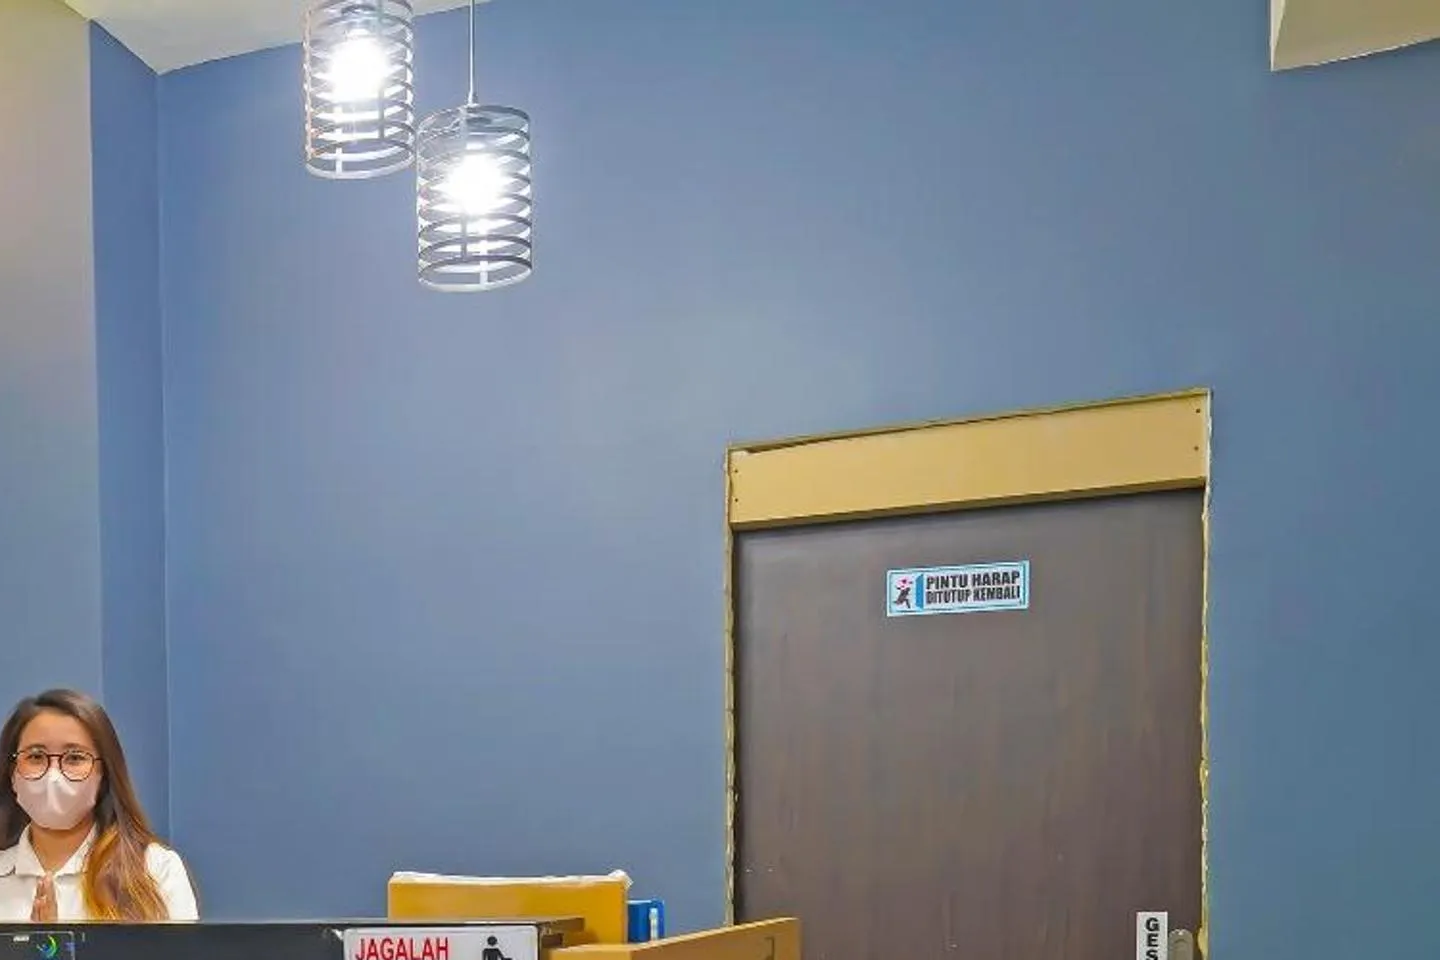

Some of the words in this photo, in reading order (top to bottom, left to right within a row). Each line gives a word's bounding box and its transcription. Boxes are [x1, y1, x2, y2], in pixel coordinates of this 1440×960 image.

[926, 574, 968, 590] PINTU
[972, 570, 1020, 586] HARAP
[926, 589, 972, 605] DITUTUP
[973, 586, 1020, 602] KEMBALI
